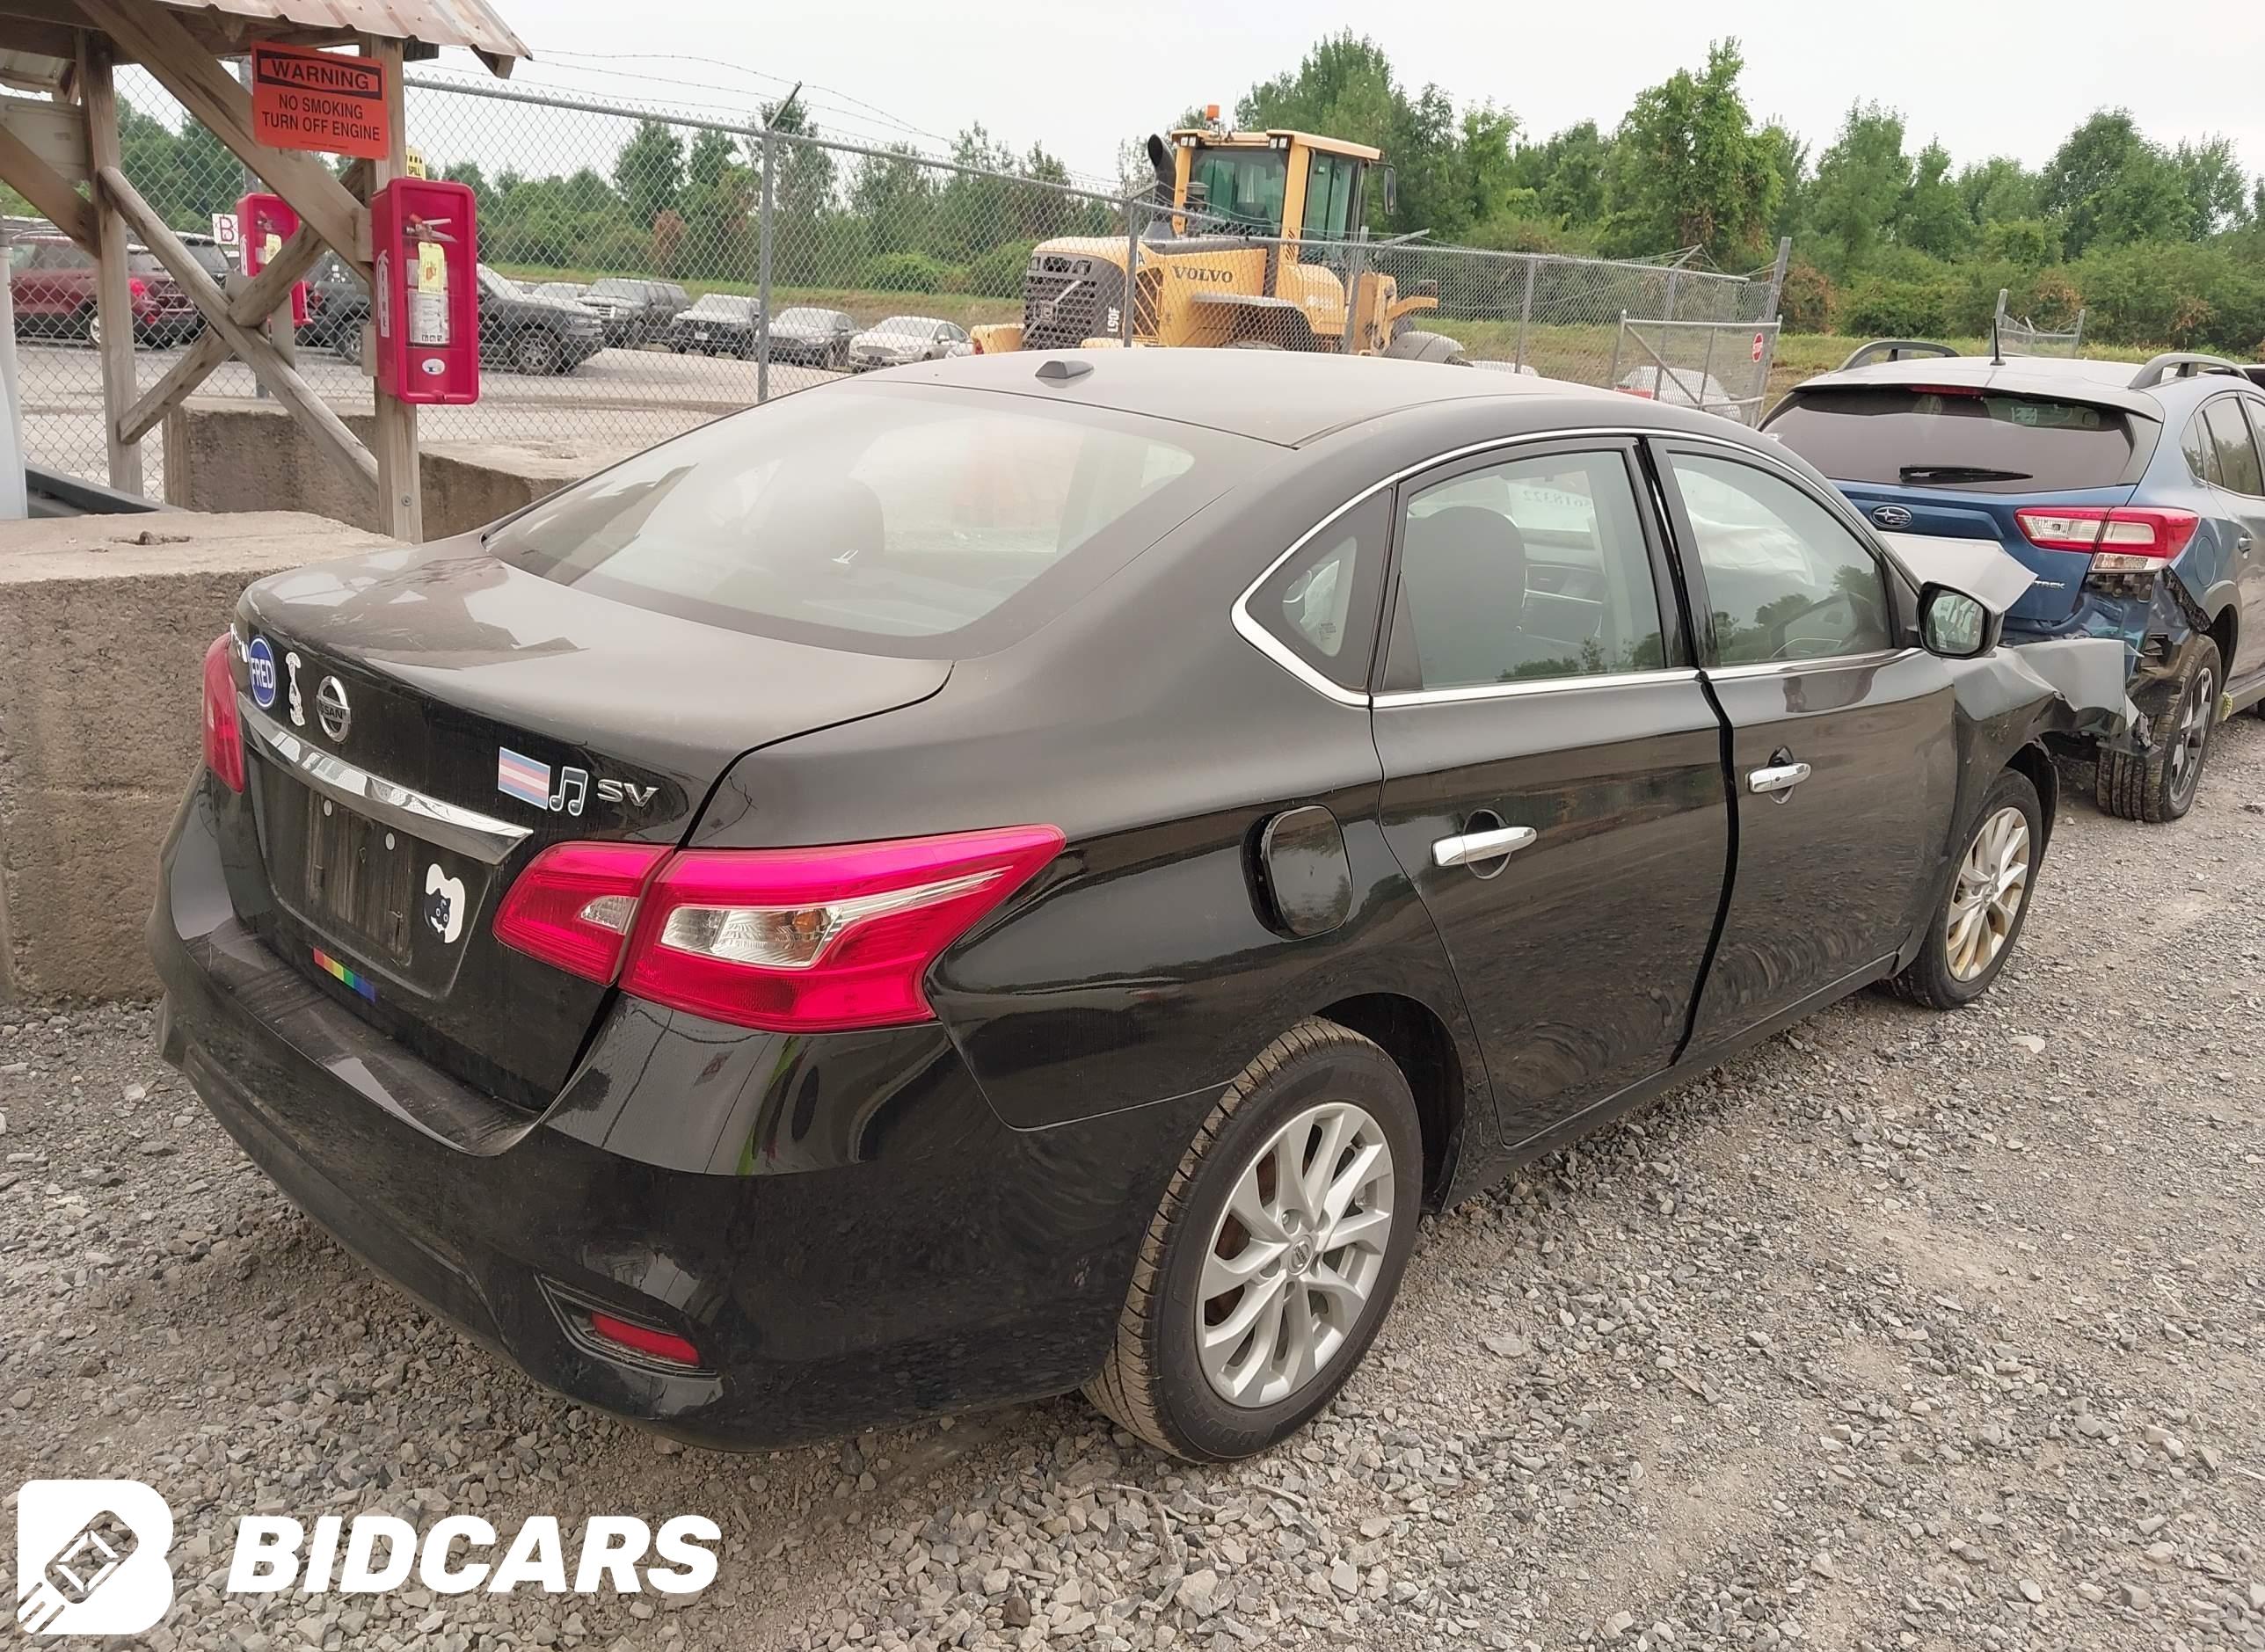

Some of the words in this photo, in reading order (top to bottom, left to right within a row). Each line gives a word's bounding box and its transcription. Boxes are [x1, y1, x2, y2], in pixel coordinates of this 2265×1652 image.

[271, 60, 369, 90] WARNING
[279, 94, 298, 111] NO
[302, 98, 363, 120] SMOKING
[262, 112, 298, 130] TURN
[302, 117, 328, 134] OFF
[332, 120, 380, 141] ENGINE
[408, 165, 420, 176] SPILL
[219, 216, 235, 242] B
[1171, 265, 1234, 283] VOLVO
[1107, 306, 1120, 332] L90F
[2034, 580, 2065, 589] TREK
[251, 657, 274, 689] FRED
[597, 779, 659, 807] SV
